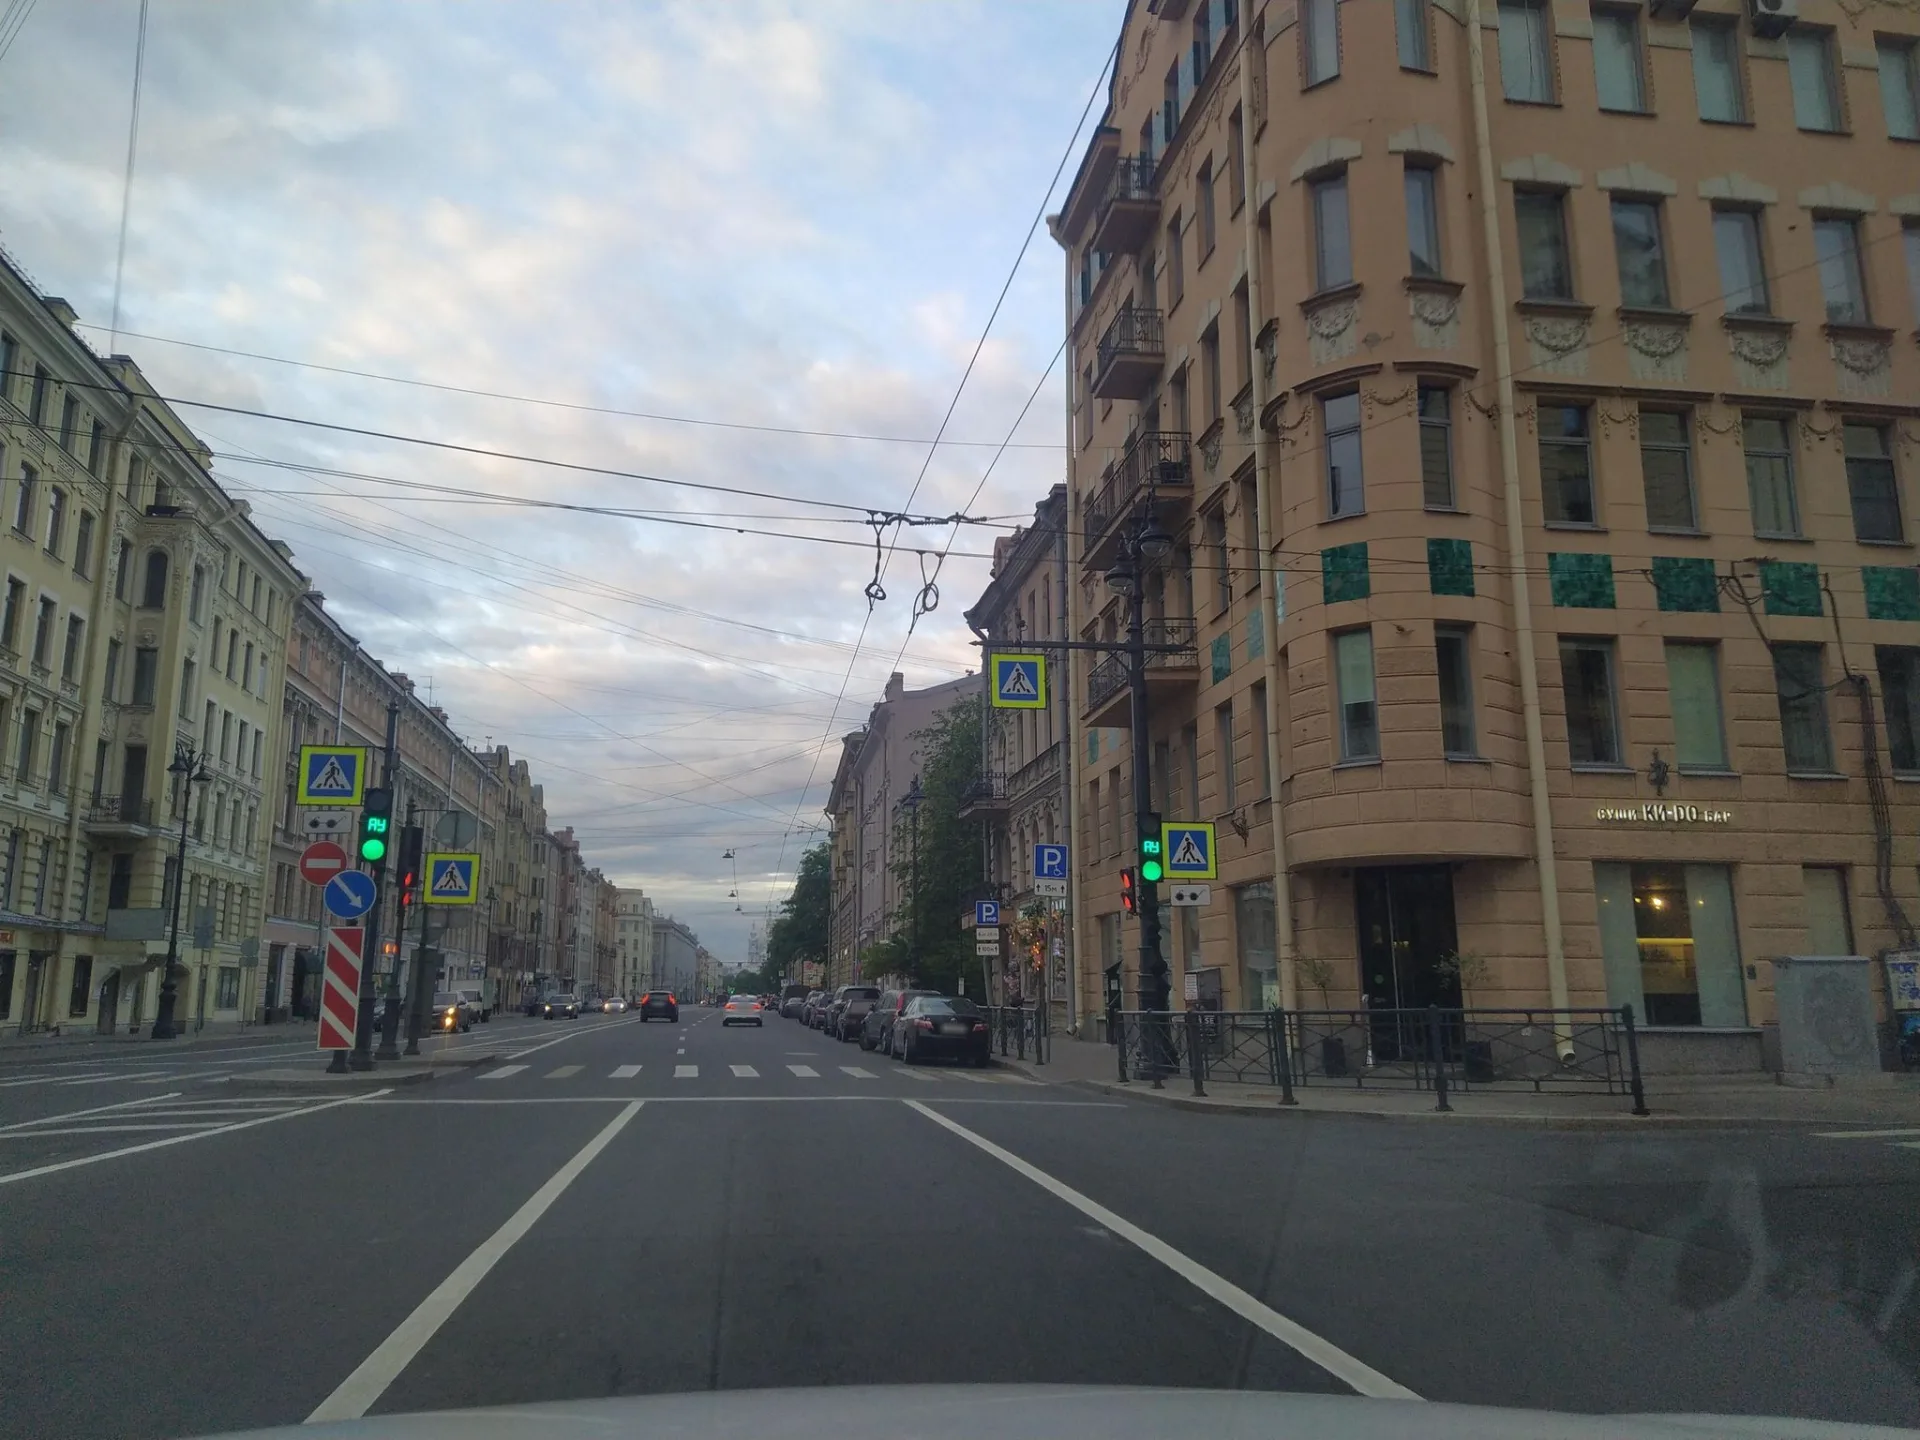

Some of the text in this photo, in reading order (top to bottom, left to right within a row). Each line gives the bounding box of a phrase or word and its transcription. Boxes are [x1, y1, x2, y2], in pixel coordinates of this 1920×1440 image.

[1704, 810, 1732, 823] БАР
[1043, 848, 1062, 874] P
[982, 903, 996, 922] P
